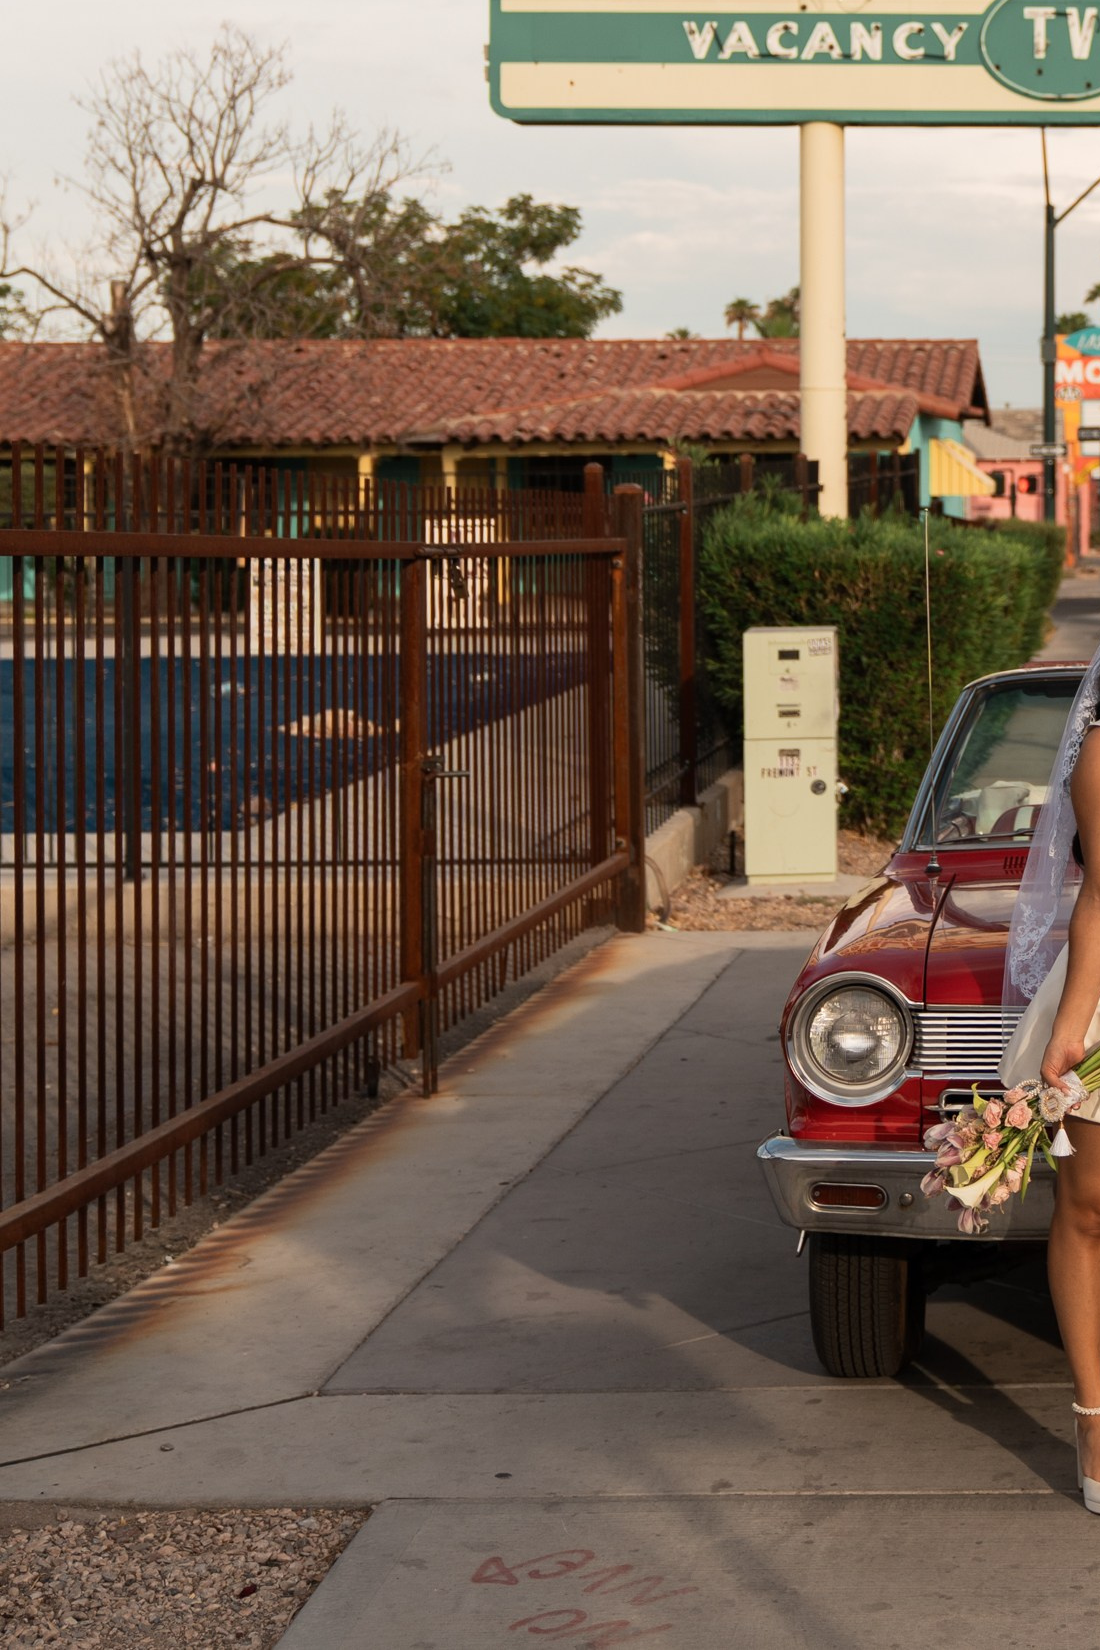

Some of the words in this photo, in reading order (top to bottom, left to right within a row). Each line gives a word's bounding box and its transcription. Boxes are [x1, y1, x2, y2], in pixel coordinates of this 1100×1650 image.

[682, 20, 969, 61] VACANCY
[1023, 6, 1100, 60] TV
[761, 767, 800, 778] FREMONT
